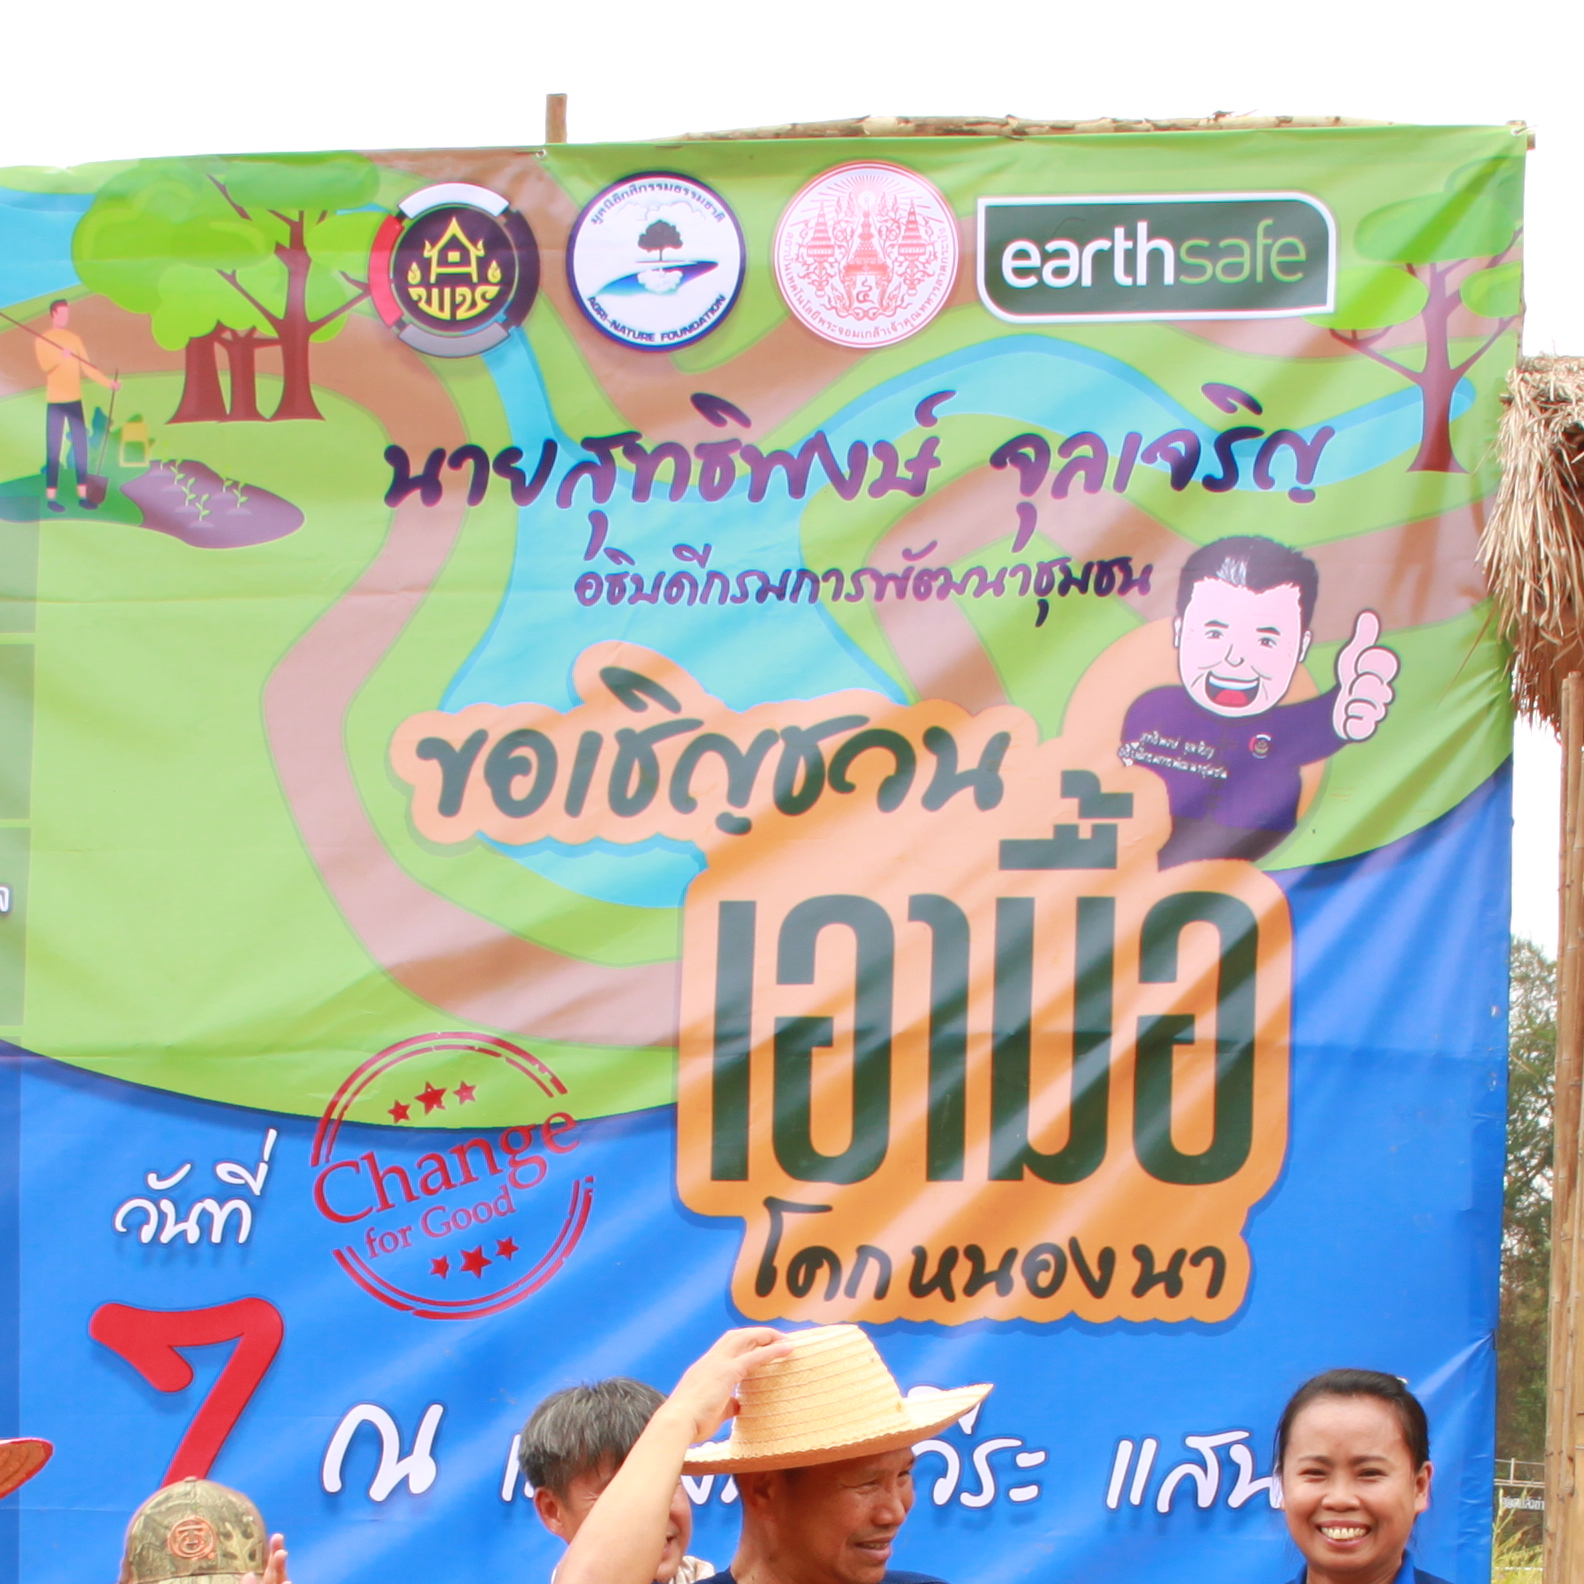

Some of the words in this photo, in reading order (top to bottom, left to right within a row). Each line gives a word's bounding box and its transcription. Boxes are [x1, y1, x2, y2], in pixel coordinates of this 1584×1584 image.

[1000, 217, 1308, 292] earthsafe
[660, 294, 727, 342] FOUNDATION
[989, 382, 1335, 548] จุลเจริญ
[417, 667, 1011, 835] ขอเชิญชวน
[711, 770, 1260, 1186] เอามื้อ
[114, 1127, 278, 1245] วันที่
[312, 1111, 582, 1225] Change
[363, 1225, 414, 1260] for
[419, 1185, 517, 1239] Good
